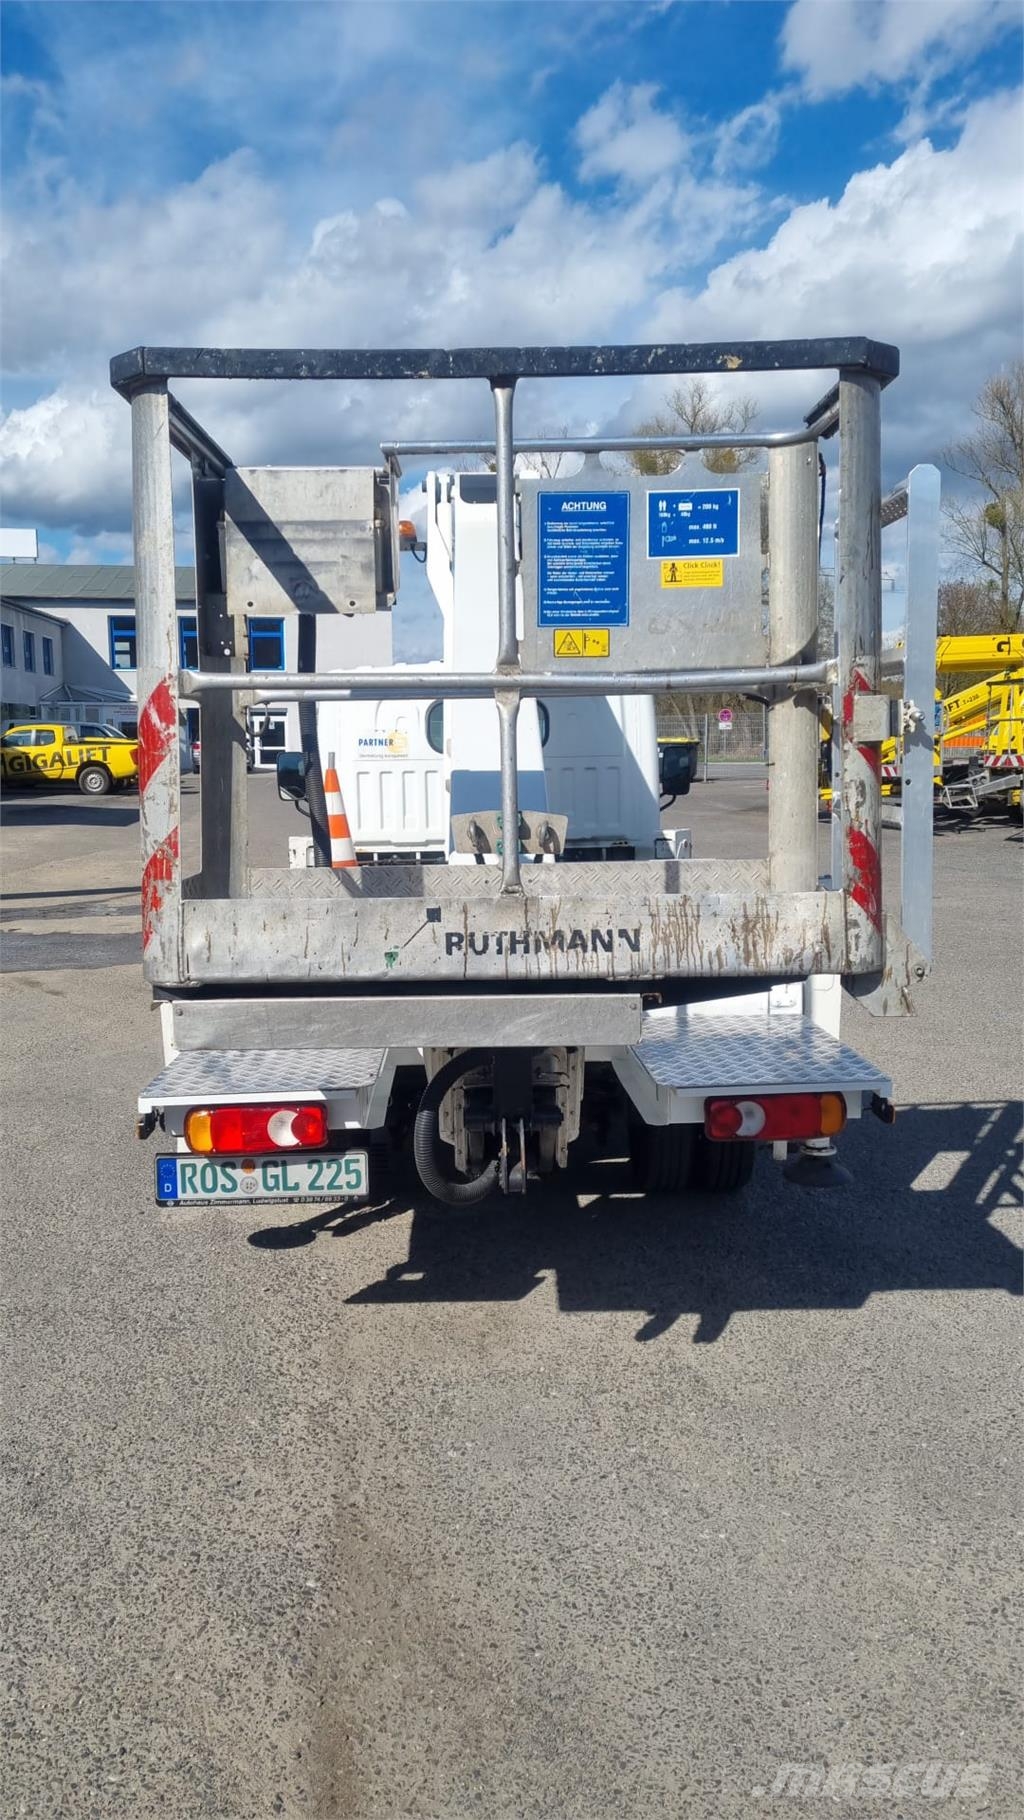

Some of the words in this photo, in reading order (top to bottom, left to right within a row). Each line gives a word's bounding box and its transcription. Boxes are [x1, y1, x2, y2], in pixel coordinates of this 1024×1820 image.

[561, 501, 607, 511] ACHTUNG
[358, 738, 394, 746] PARTNER
[9, 746, 111, 772] GIGALIFT
[445, 929, 641, 956] RUTHMANN
[180, 1163, 238, 1194] ROS
[262, 1160, 299, 1192] GL
[307, 1158, 361, 1190] 225
[164, 1183, 172, 1193] D
